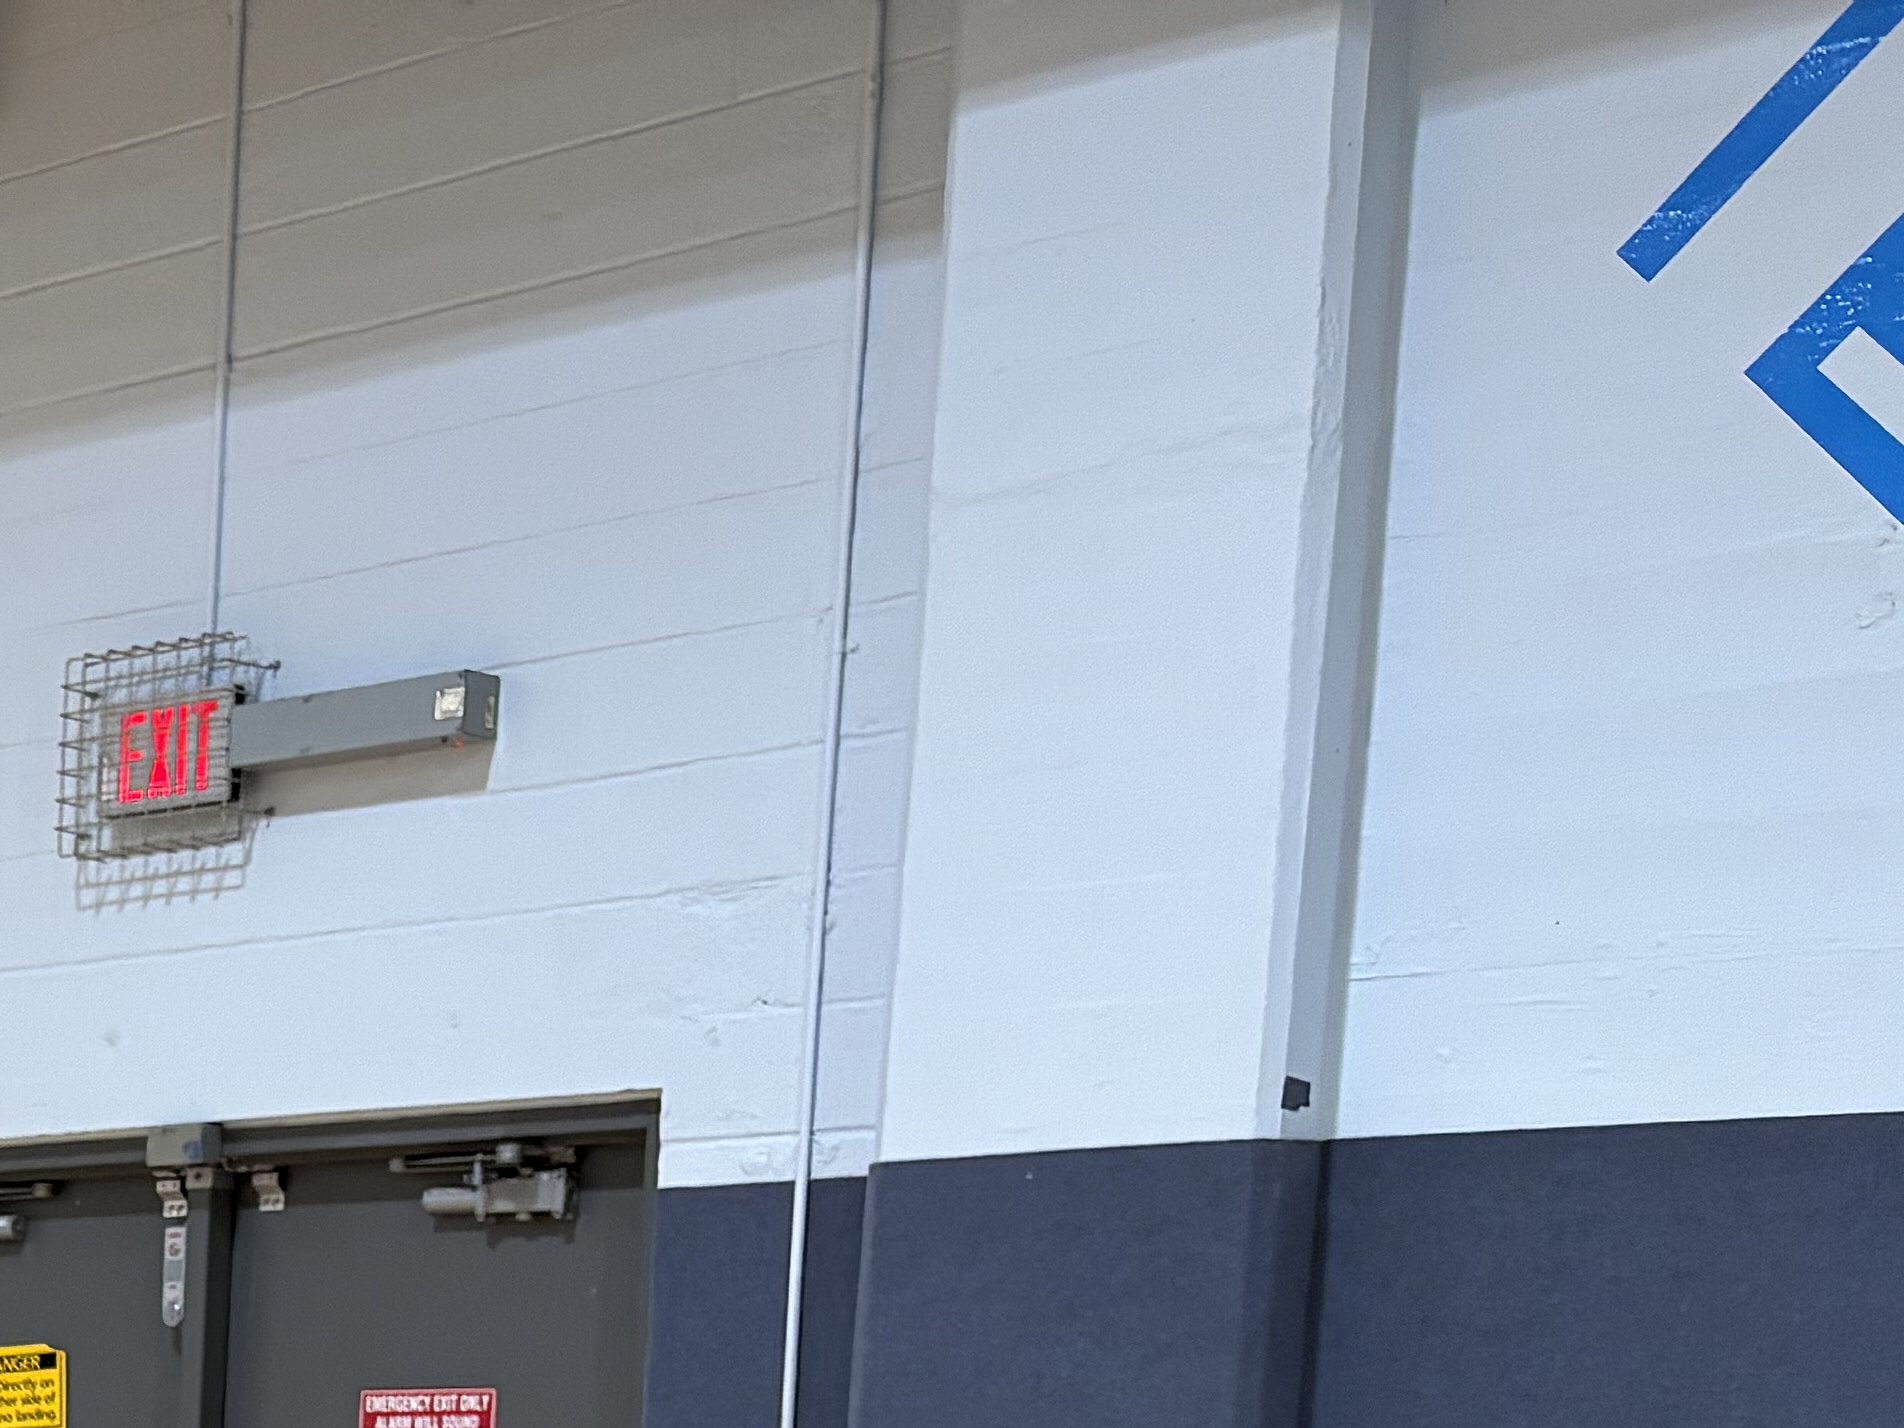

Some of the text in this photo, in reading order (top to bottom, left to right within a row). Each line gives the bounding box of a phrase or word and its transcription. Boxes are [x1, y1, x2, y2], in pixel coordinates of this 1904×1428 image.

[118, 700, 219, 804] EXIT
[40, 1378, 55, 1389] on
[20, 1394, 43, 1406] side
[43, 1390, 56, 1405] of
[365, 1394, 490, 1413] EMERGENCY EXIT ONLY
